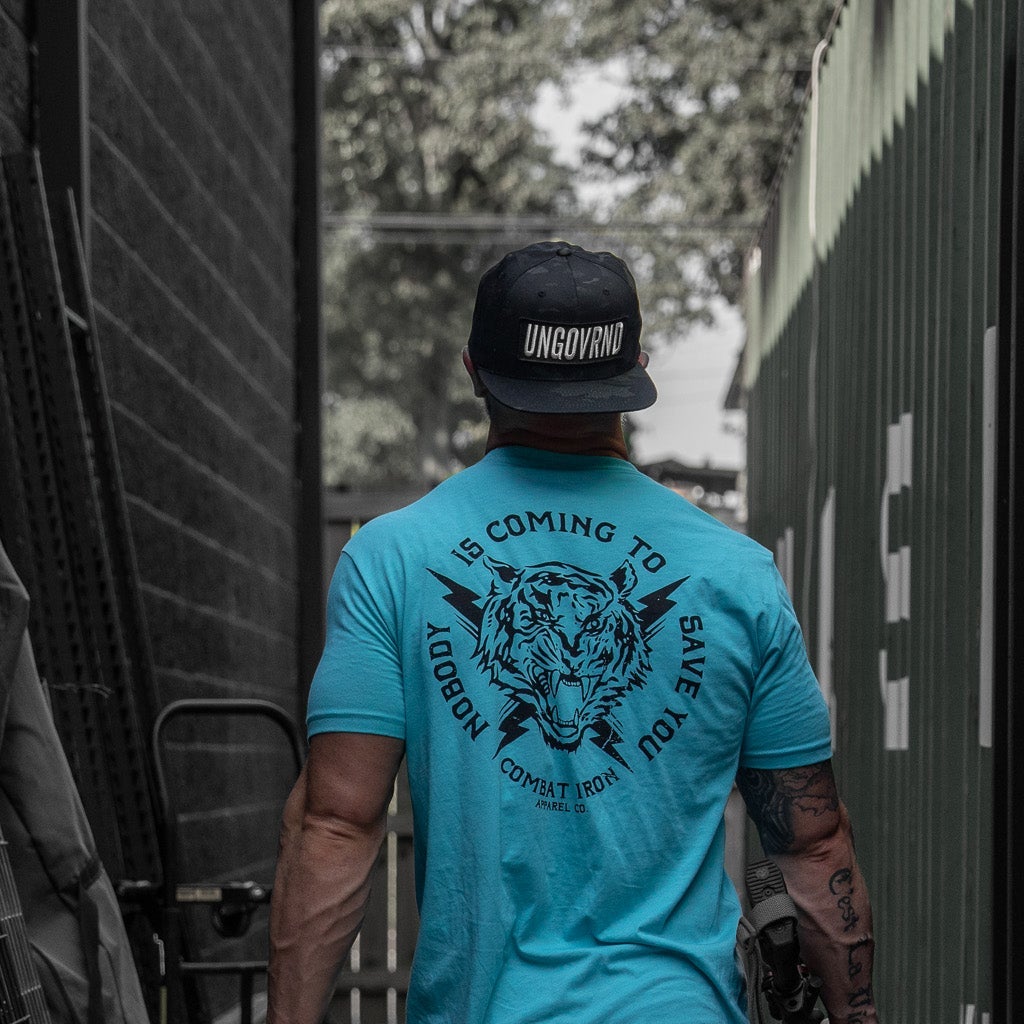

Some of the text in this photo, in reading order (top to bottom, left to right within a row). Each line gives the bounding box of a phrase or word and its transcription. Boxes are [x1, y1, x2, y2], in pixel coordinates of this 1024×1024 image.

[524, 321, 624, 360] UNGOVRND
[427, 511, 706, 761] NOBODY IS COMING TO SAVE YOU
[500, 757, 620, 799] COMBAT IRON
[535, 799, 571, 812] APPAREL
